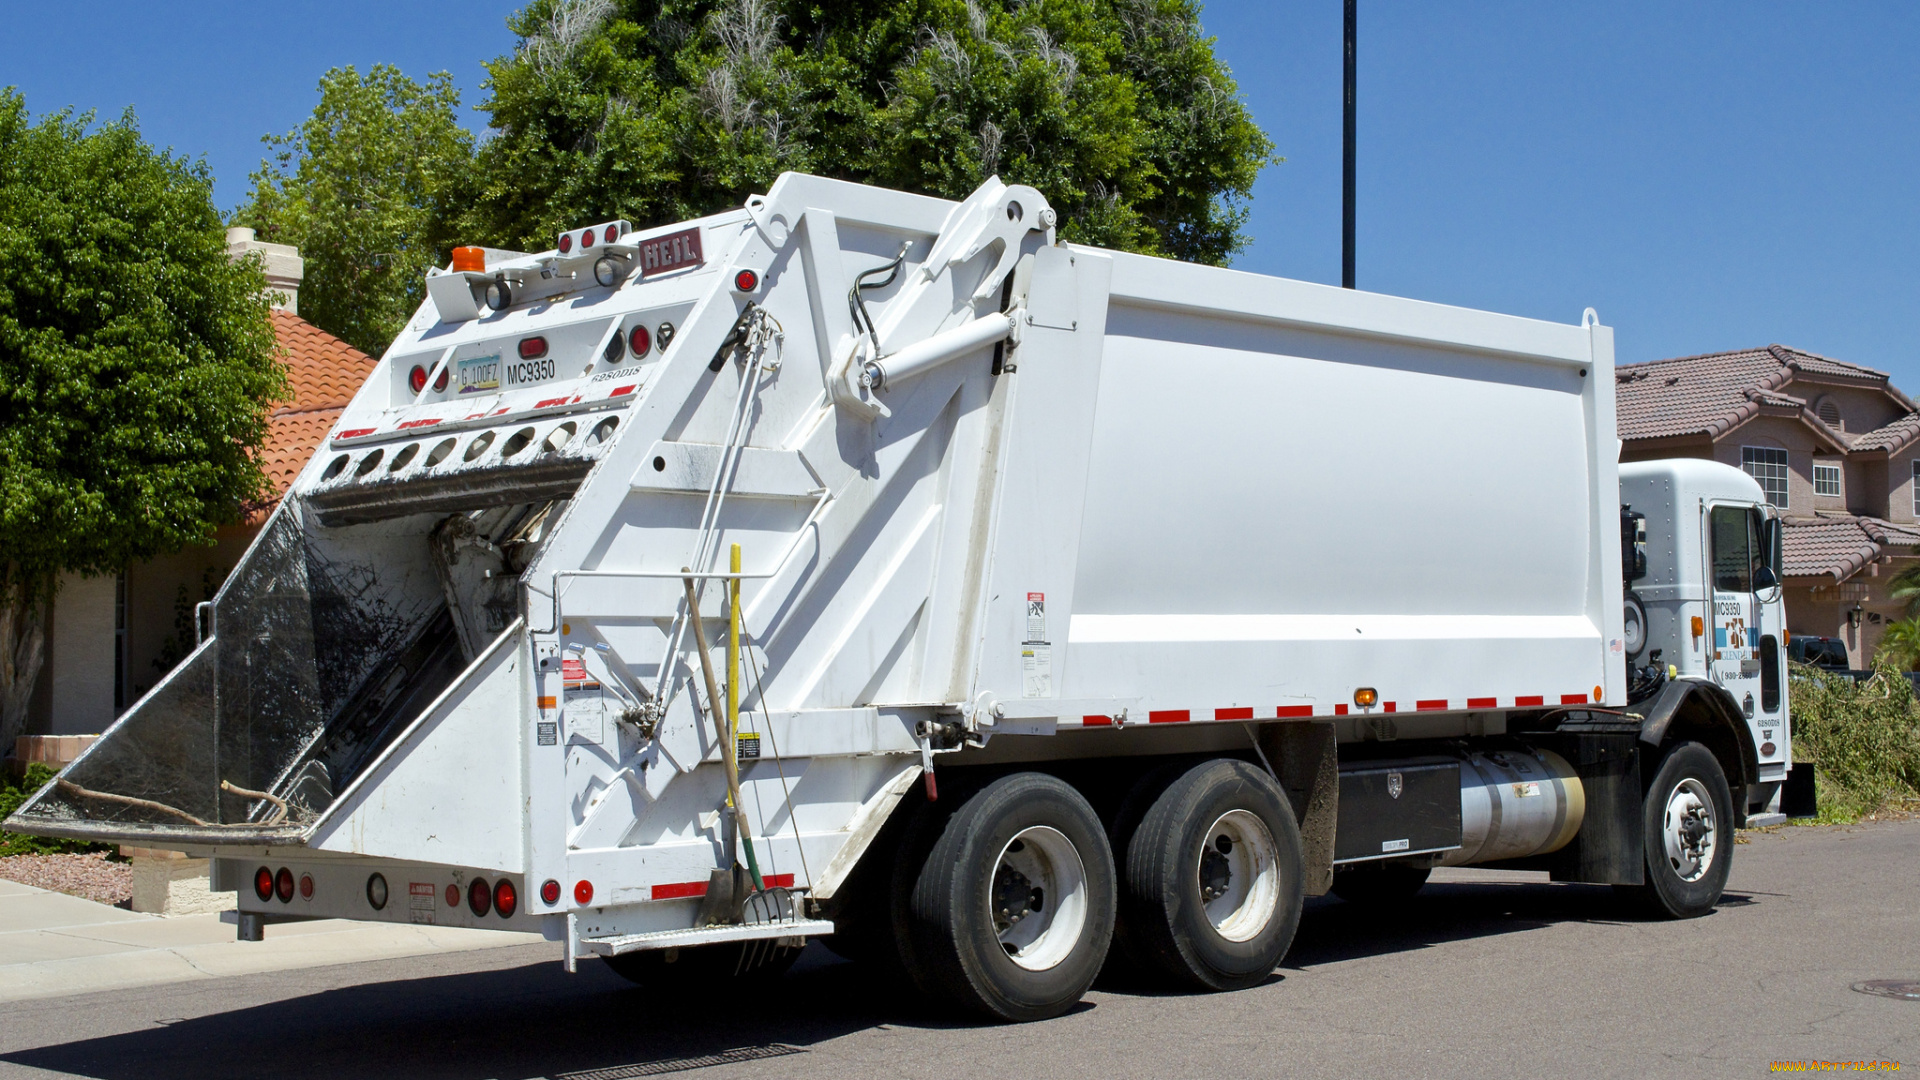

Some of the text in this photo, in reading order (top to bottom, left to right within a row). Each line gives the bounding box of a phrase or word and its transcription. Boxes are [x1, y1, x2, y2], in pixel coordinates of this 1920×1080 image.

[643, 235, 697, 270] HEIL
[461, 368, 468, 386] G
[507, 359, 555, 385] MC9350
[1714, 602, 1741, 616] MC9350
